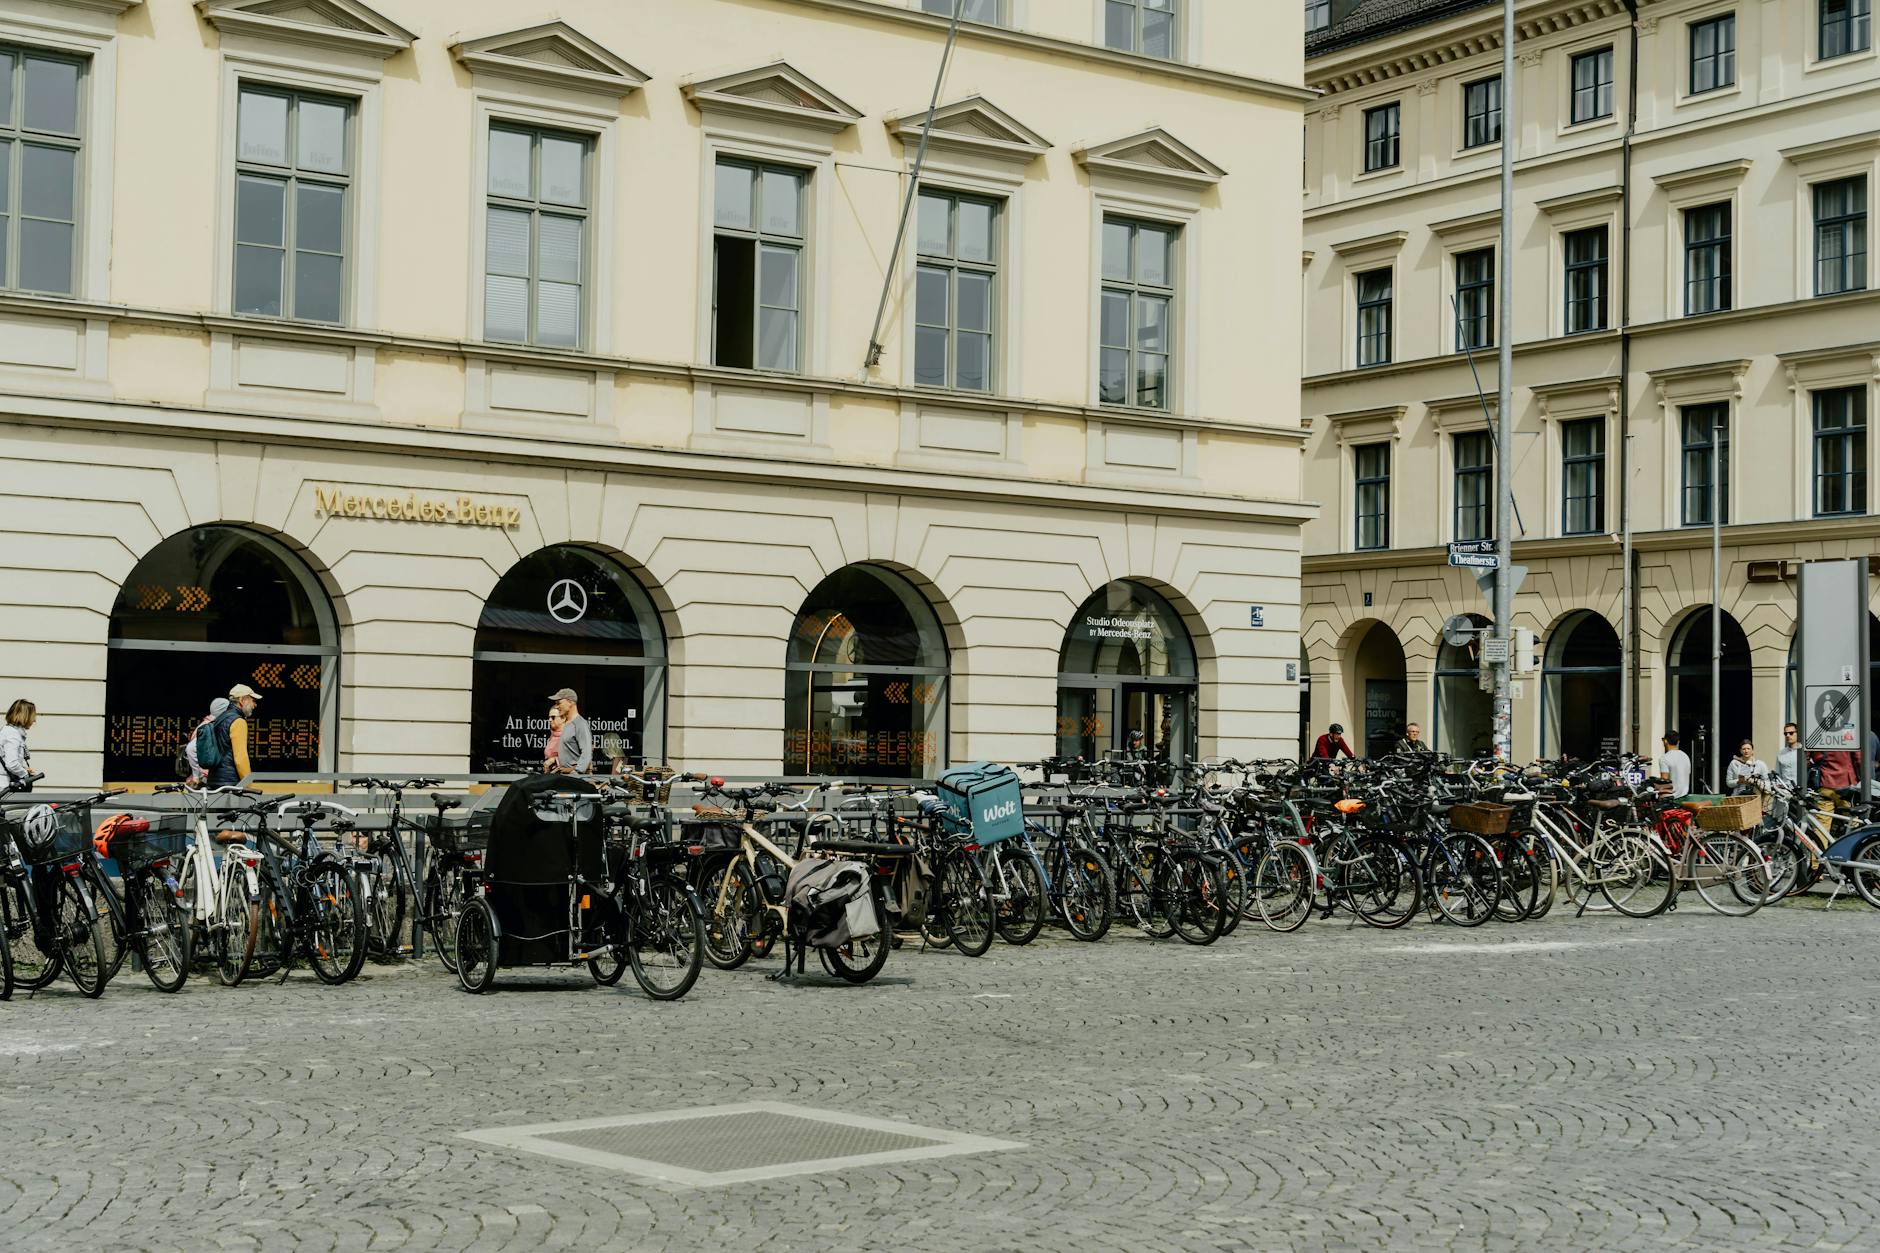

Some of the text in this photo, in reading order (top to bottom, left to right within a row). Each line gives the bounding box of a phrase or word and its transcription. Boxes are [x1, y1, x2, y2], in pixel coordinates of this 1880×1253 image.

[314, 486, 520, 529] Mercedes-Benz
[1450, 542, 1493, 553] Brienner Str.
[1086, 616, 1155, 629] Studio Odeonsplatz
[1089, 628, 1152, 639] BY Mercedes-Benz
[1367, 706, 1397, 718] nature
[111, 715, 180, 729] VISION
[504, 714, 523, 730] An
[587, 716, 628, 732] isioned
[111, 729, 180, 743] VISION
[502, 733, 522, 748] the
[1819, 735, 1847, 745] ZONE
[111, 743, 180, 757] VISION
[983, 800, 1016, 823] Wolt
